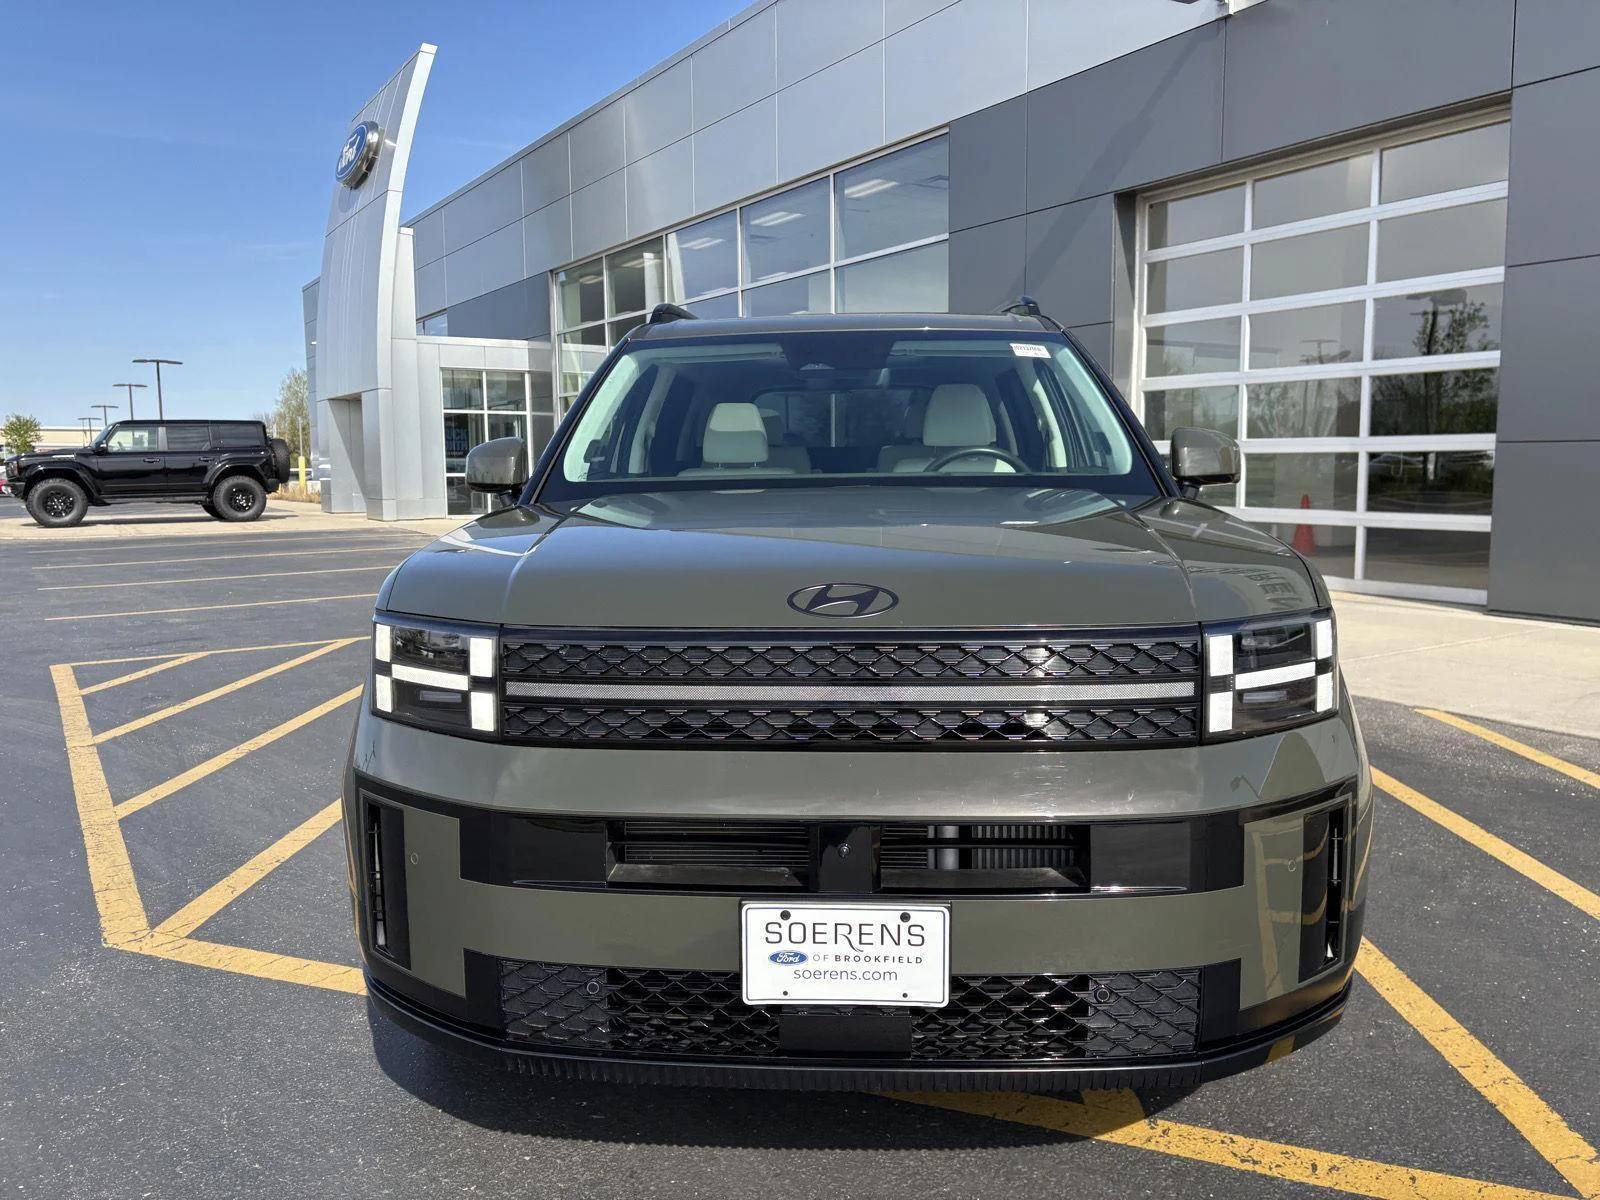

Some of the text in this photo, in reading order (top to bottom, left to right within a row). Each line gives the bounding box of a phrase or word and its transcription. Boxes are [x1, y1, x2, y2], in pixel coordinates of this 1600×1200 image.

[765, 922, 925, 952] SOERENS
[813, 954, 829, 962] OF
[835, 954, 922, 964] BROOKFIELD
[793, 969, 898, 981] soerens.com
